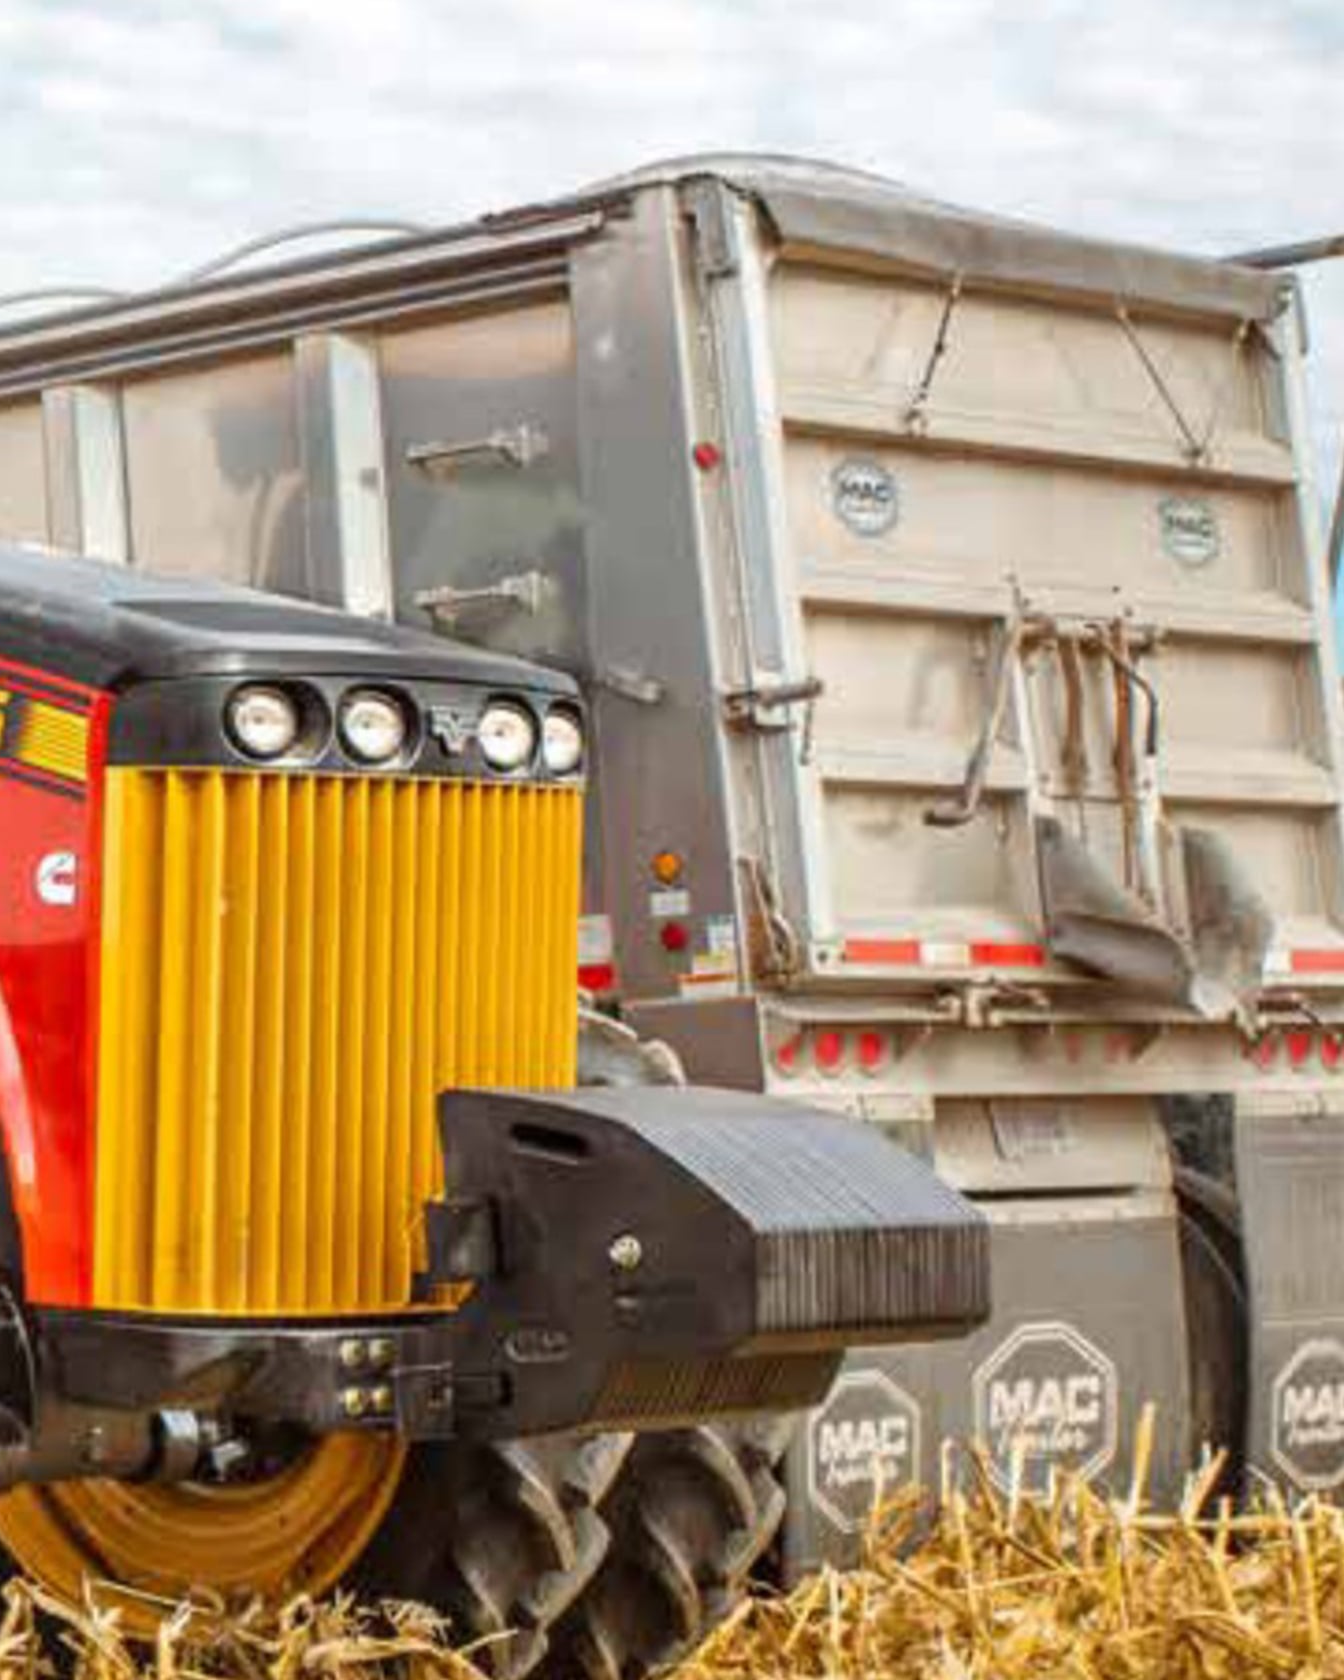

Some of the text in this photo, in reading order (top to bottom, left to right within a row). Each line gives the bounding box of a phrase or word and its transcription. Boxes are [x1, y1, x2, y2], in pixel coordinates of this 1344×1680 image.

[989, 1375, 1100, 1430] MAC
[1284, 1384, 1344, 1422] MA
[819, 1416, 908, 1464] MAC
